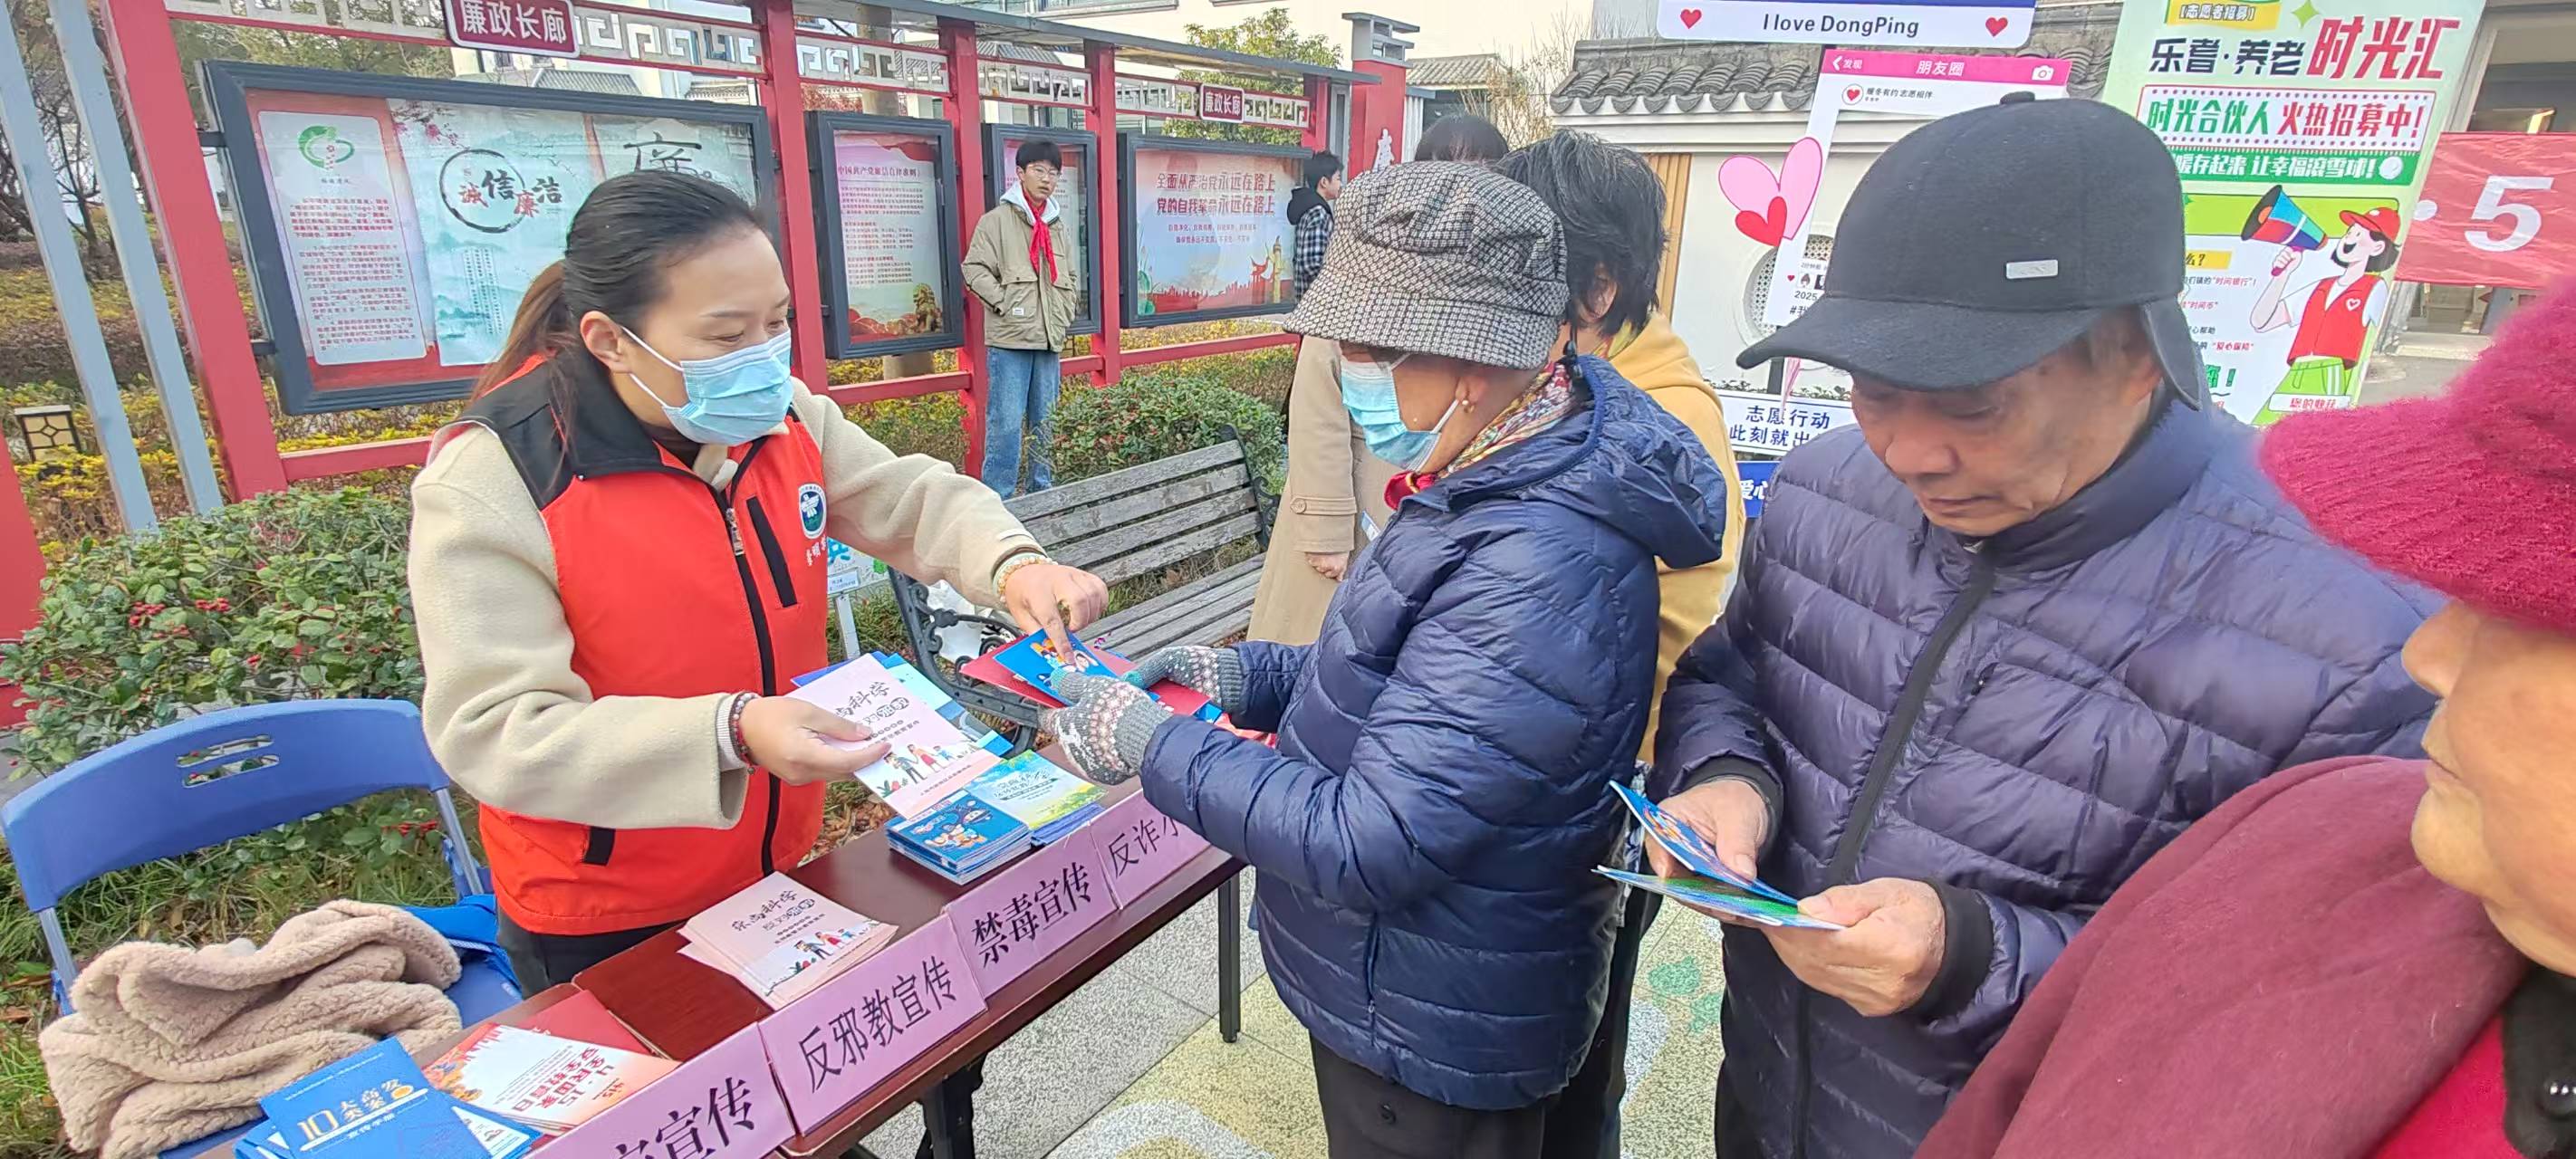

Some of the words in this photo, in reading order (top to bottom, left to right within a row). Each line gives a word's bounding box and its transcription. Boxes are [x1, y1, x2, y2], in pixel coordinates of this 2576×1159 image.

[460, 0, 567, 43] 廉政长廊
[1763, 14, 1769, 30] I
[1773, 14, 1815, 32] love
[1821, 14, 1919, 38] DongPing
[1842, 59, 1863, 70] 发现
[1916, 60, 1965, 77] 朋友圈
[1205, 91, 1241, 116] 廉政长廊
[2147, 98, 2269, 135] 时光合伙人
[1157, 172, 1276, 192] 全面从严治党永远在路上
[1157, 195, 1275, 216] 党的自我革命永远在路上
[1745, 405, 1831, 430] 志愿行动
[971, 862, 1091, 968] 禁毒宣传
[798, 955, 956, 1094] 反邪教宣传
[616, 1077, 755, 1159] 宣传
